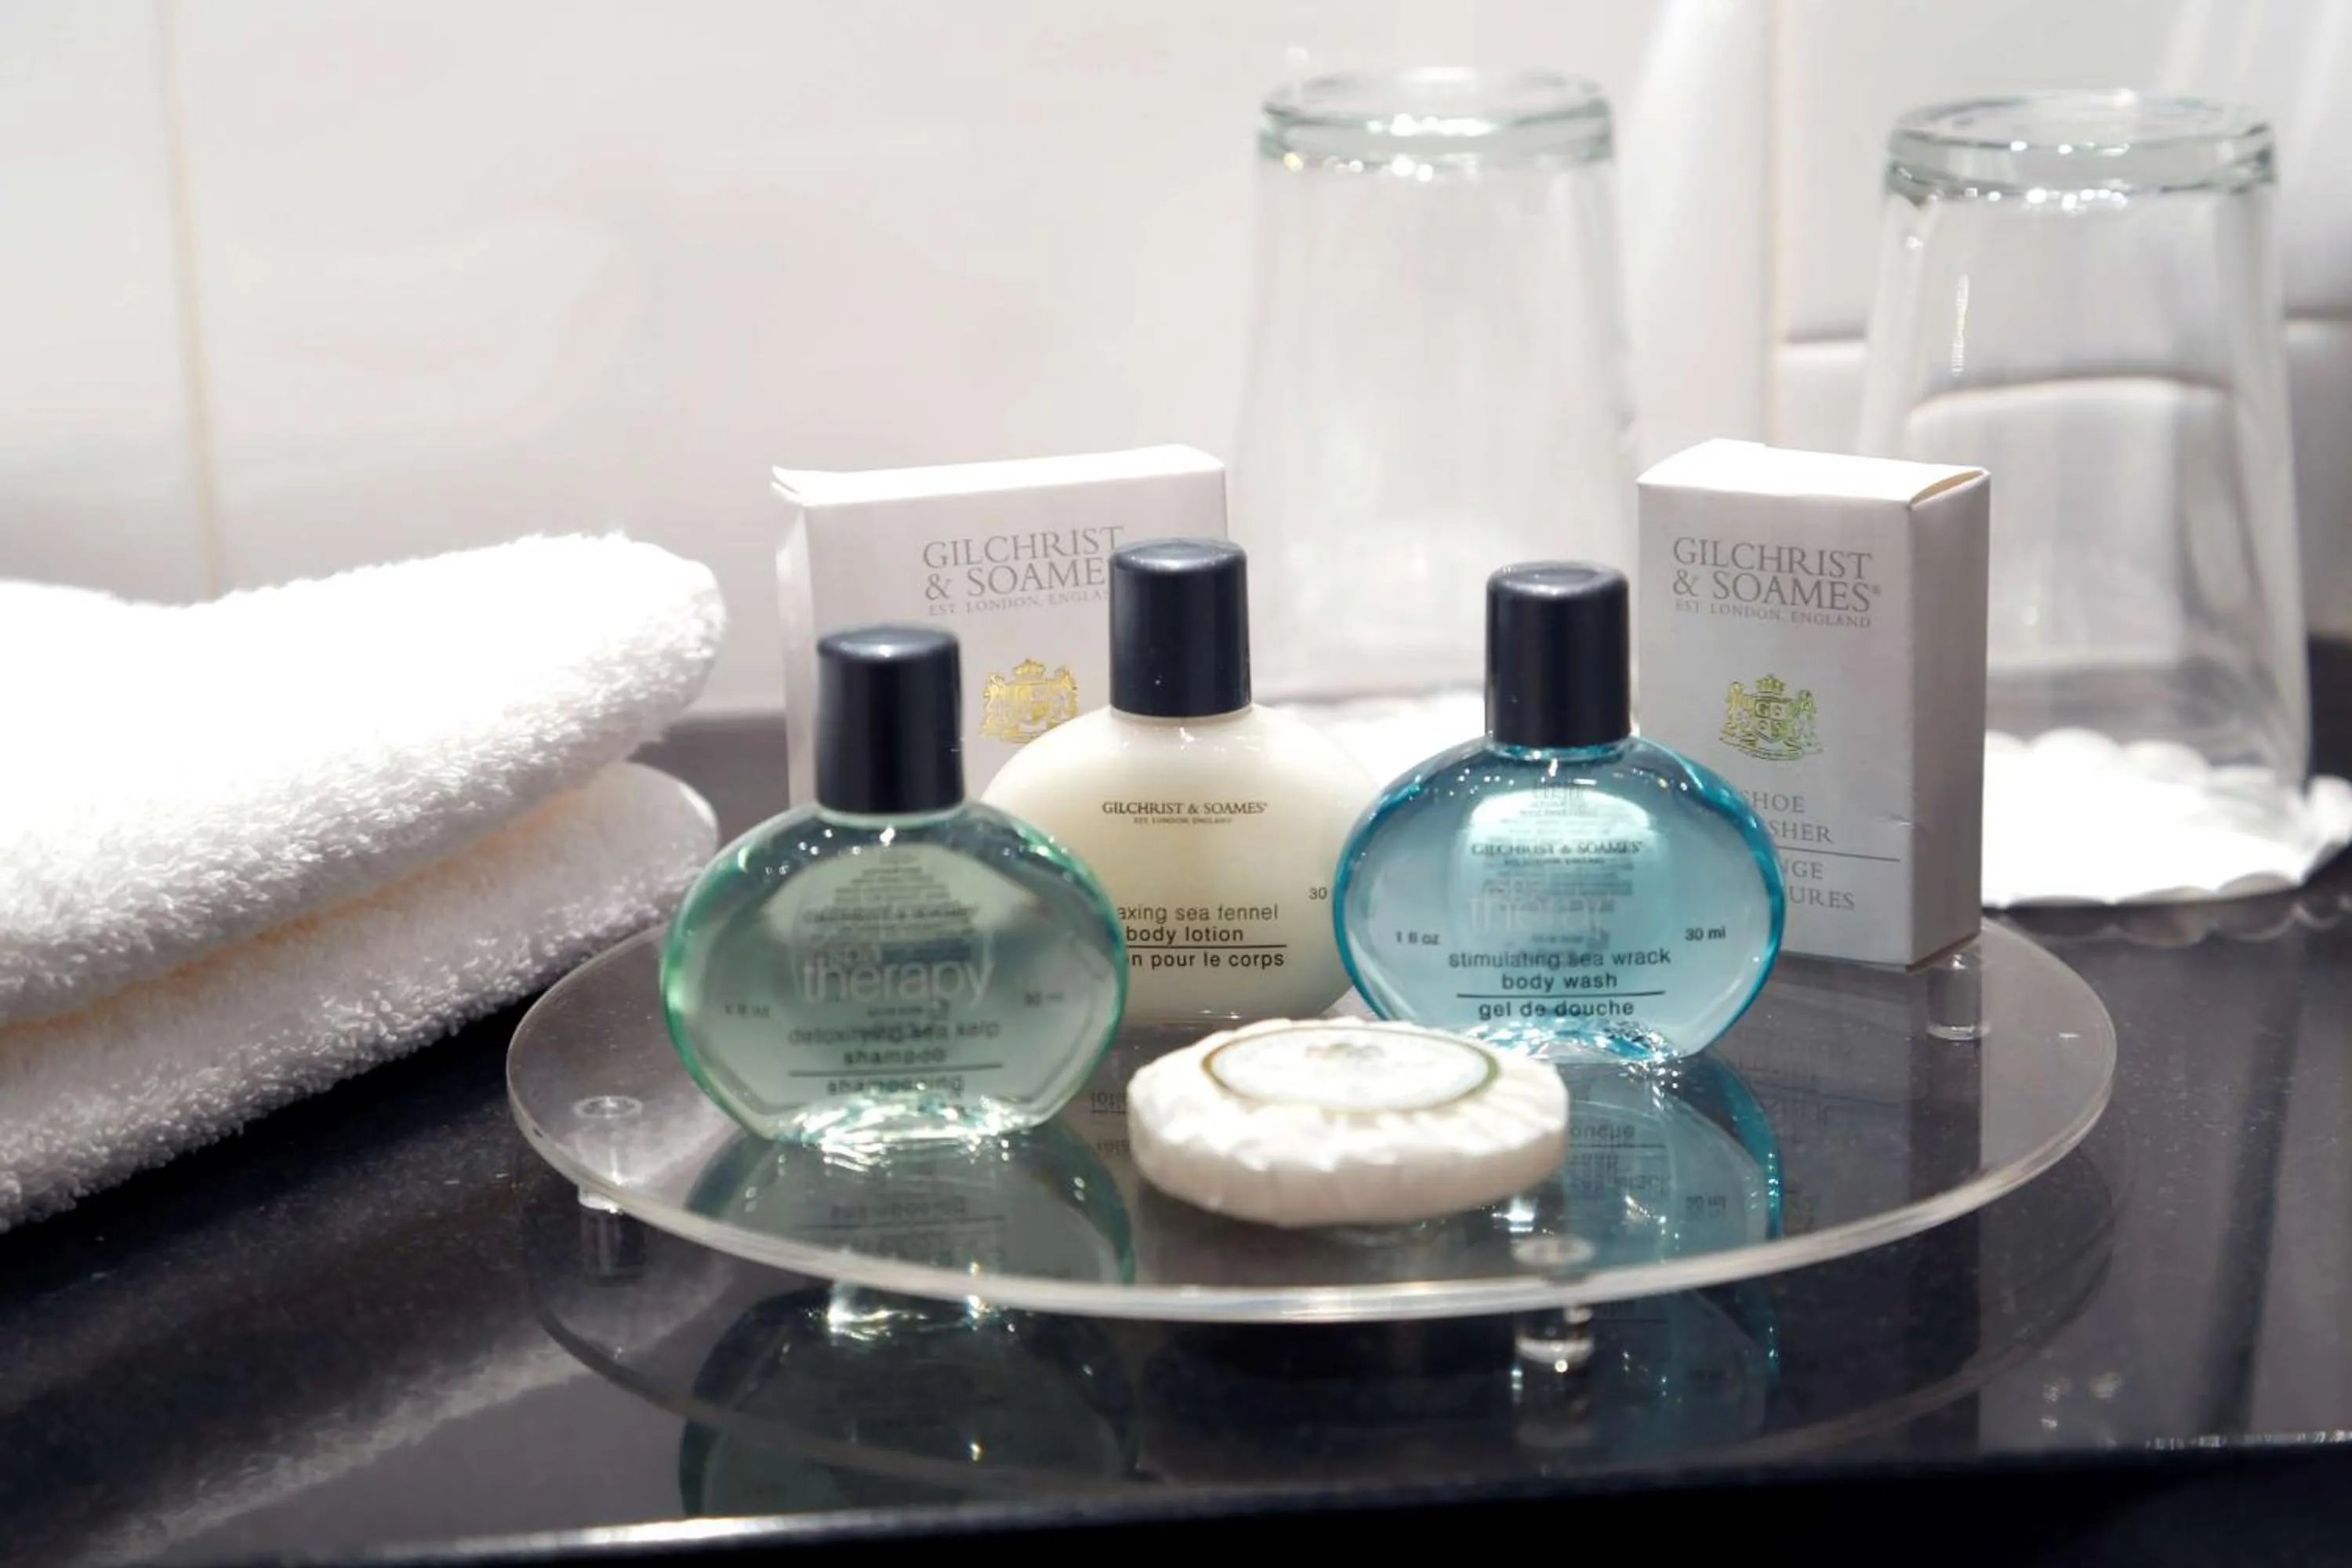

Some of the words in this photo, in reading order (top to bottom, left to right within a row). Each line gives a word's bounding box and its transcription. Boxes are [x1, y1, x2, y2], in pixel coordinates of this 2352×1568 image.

[923, 525, 1123, 569] GILCHRIST
[1673, 536, 1872, 579] GILCHRIST
[925, 573, 952, 601] &
[967, 557, 1107, 597] SOAME
[1672, 568, 1699, 598] &
[1049, 590, 1109, 605] ENGLA
[1791, 610, 1871, 628] ENGLAND
[1102, 800, 1185, 815] GILCHRIST
[1187, 802, 1198, 815] &
[1769, 819, 1834, 844] SHER
[1308, 886, 1328, 901] 30
[1788, 885, 1856, 910] URES
[1118, 905, 1167, 924] axing
[1175, 906, 1210, 921] sea
[1218, 903, 1279, 921] fennel
[1126, 925, 1177, 945] body
[1185, 926, 1244, 942] lotion
[1685, 927, 1704, 942] 30
[1708, 924, 1726, 940] ml
[1151, 953, 1196, 971] pour
[1203, 951, 1221, 967] le
[1229, 951, 1285, 971] corps
[1449, 949, 1560, 971] stimulating
[1567, 951, 1605, 967] sea
[1611, 946, 1672, 966] wrack
[802, 955, 995, 1009] therapy
[1501, 973, 1555, 993] body
[1563, 971, 1619, 989] wash
[1479, 1000, 1512, 1019] gel
[1519, 1000, 1548, 1018] de
[1554, 998, 1635, 1018] douche
[844, 1047, 946, 1065] shampoo
